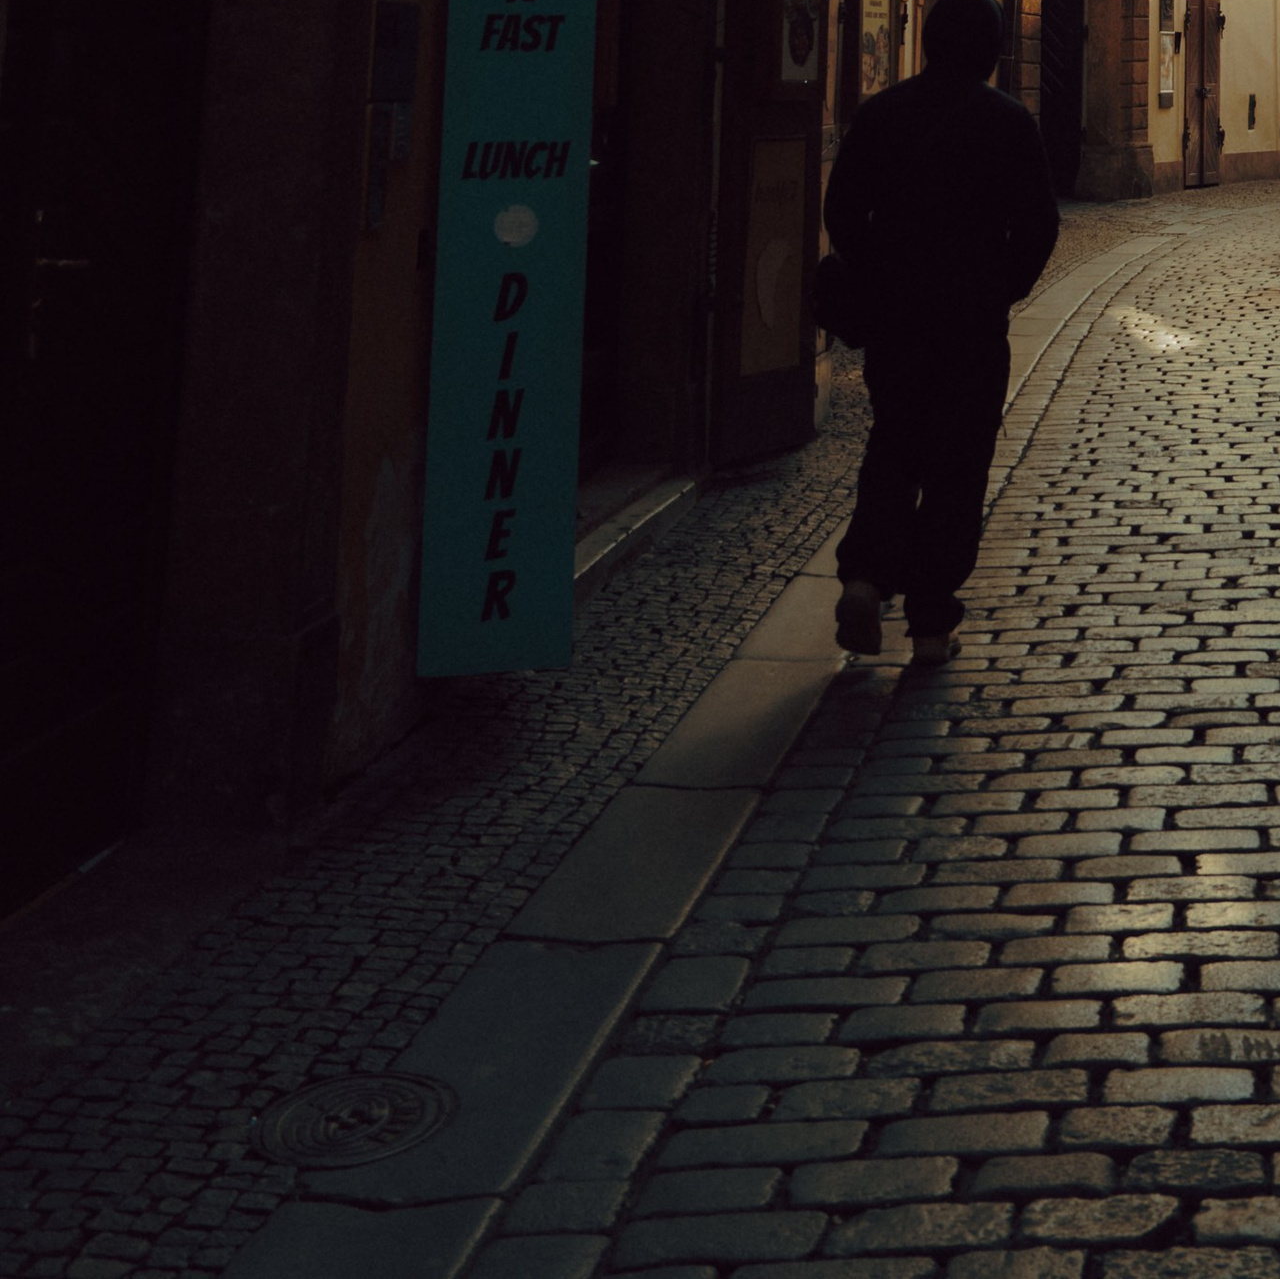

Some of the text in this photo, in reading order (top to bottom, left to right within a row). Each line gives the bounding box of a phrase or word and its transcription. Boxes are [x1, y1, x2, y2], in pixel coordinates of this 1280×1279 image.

[480, 15, 565, 52] FAST
[461, 141, 570, 179] LUNCH
[480, 273, 528, 622] DINNER
